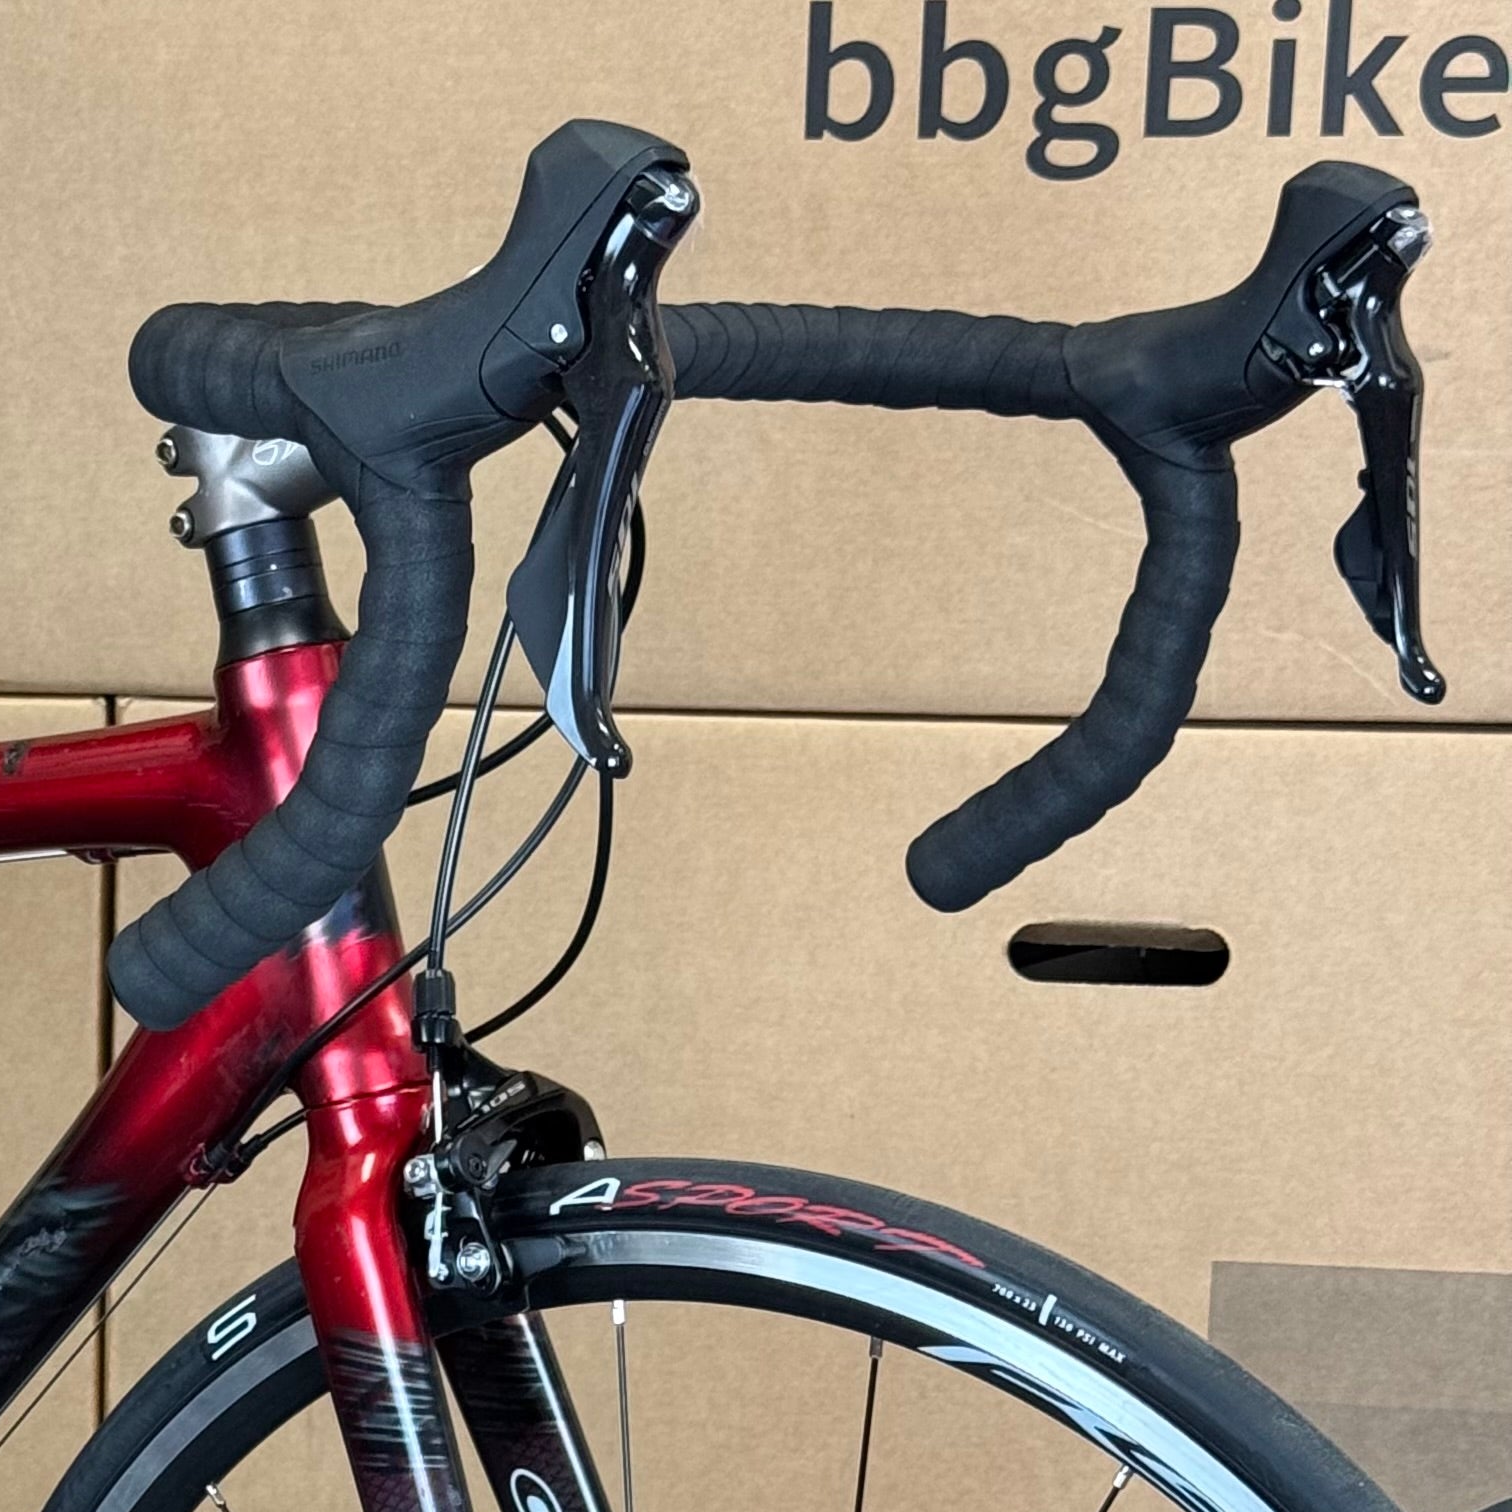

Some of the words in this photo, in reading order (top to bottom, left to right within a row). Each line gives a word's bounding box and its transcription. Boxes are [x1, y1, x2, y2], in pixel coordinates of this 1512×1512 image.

[310, 341, 401, 375] SHIMANO
[1076, 1328, 1096, 1346] PSI
[1098, 1342, 1127, 1364] MAX
